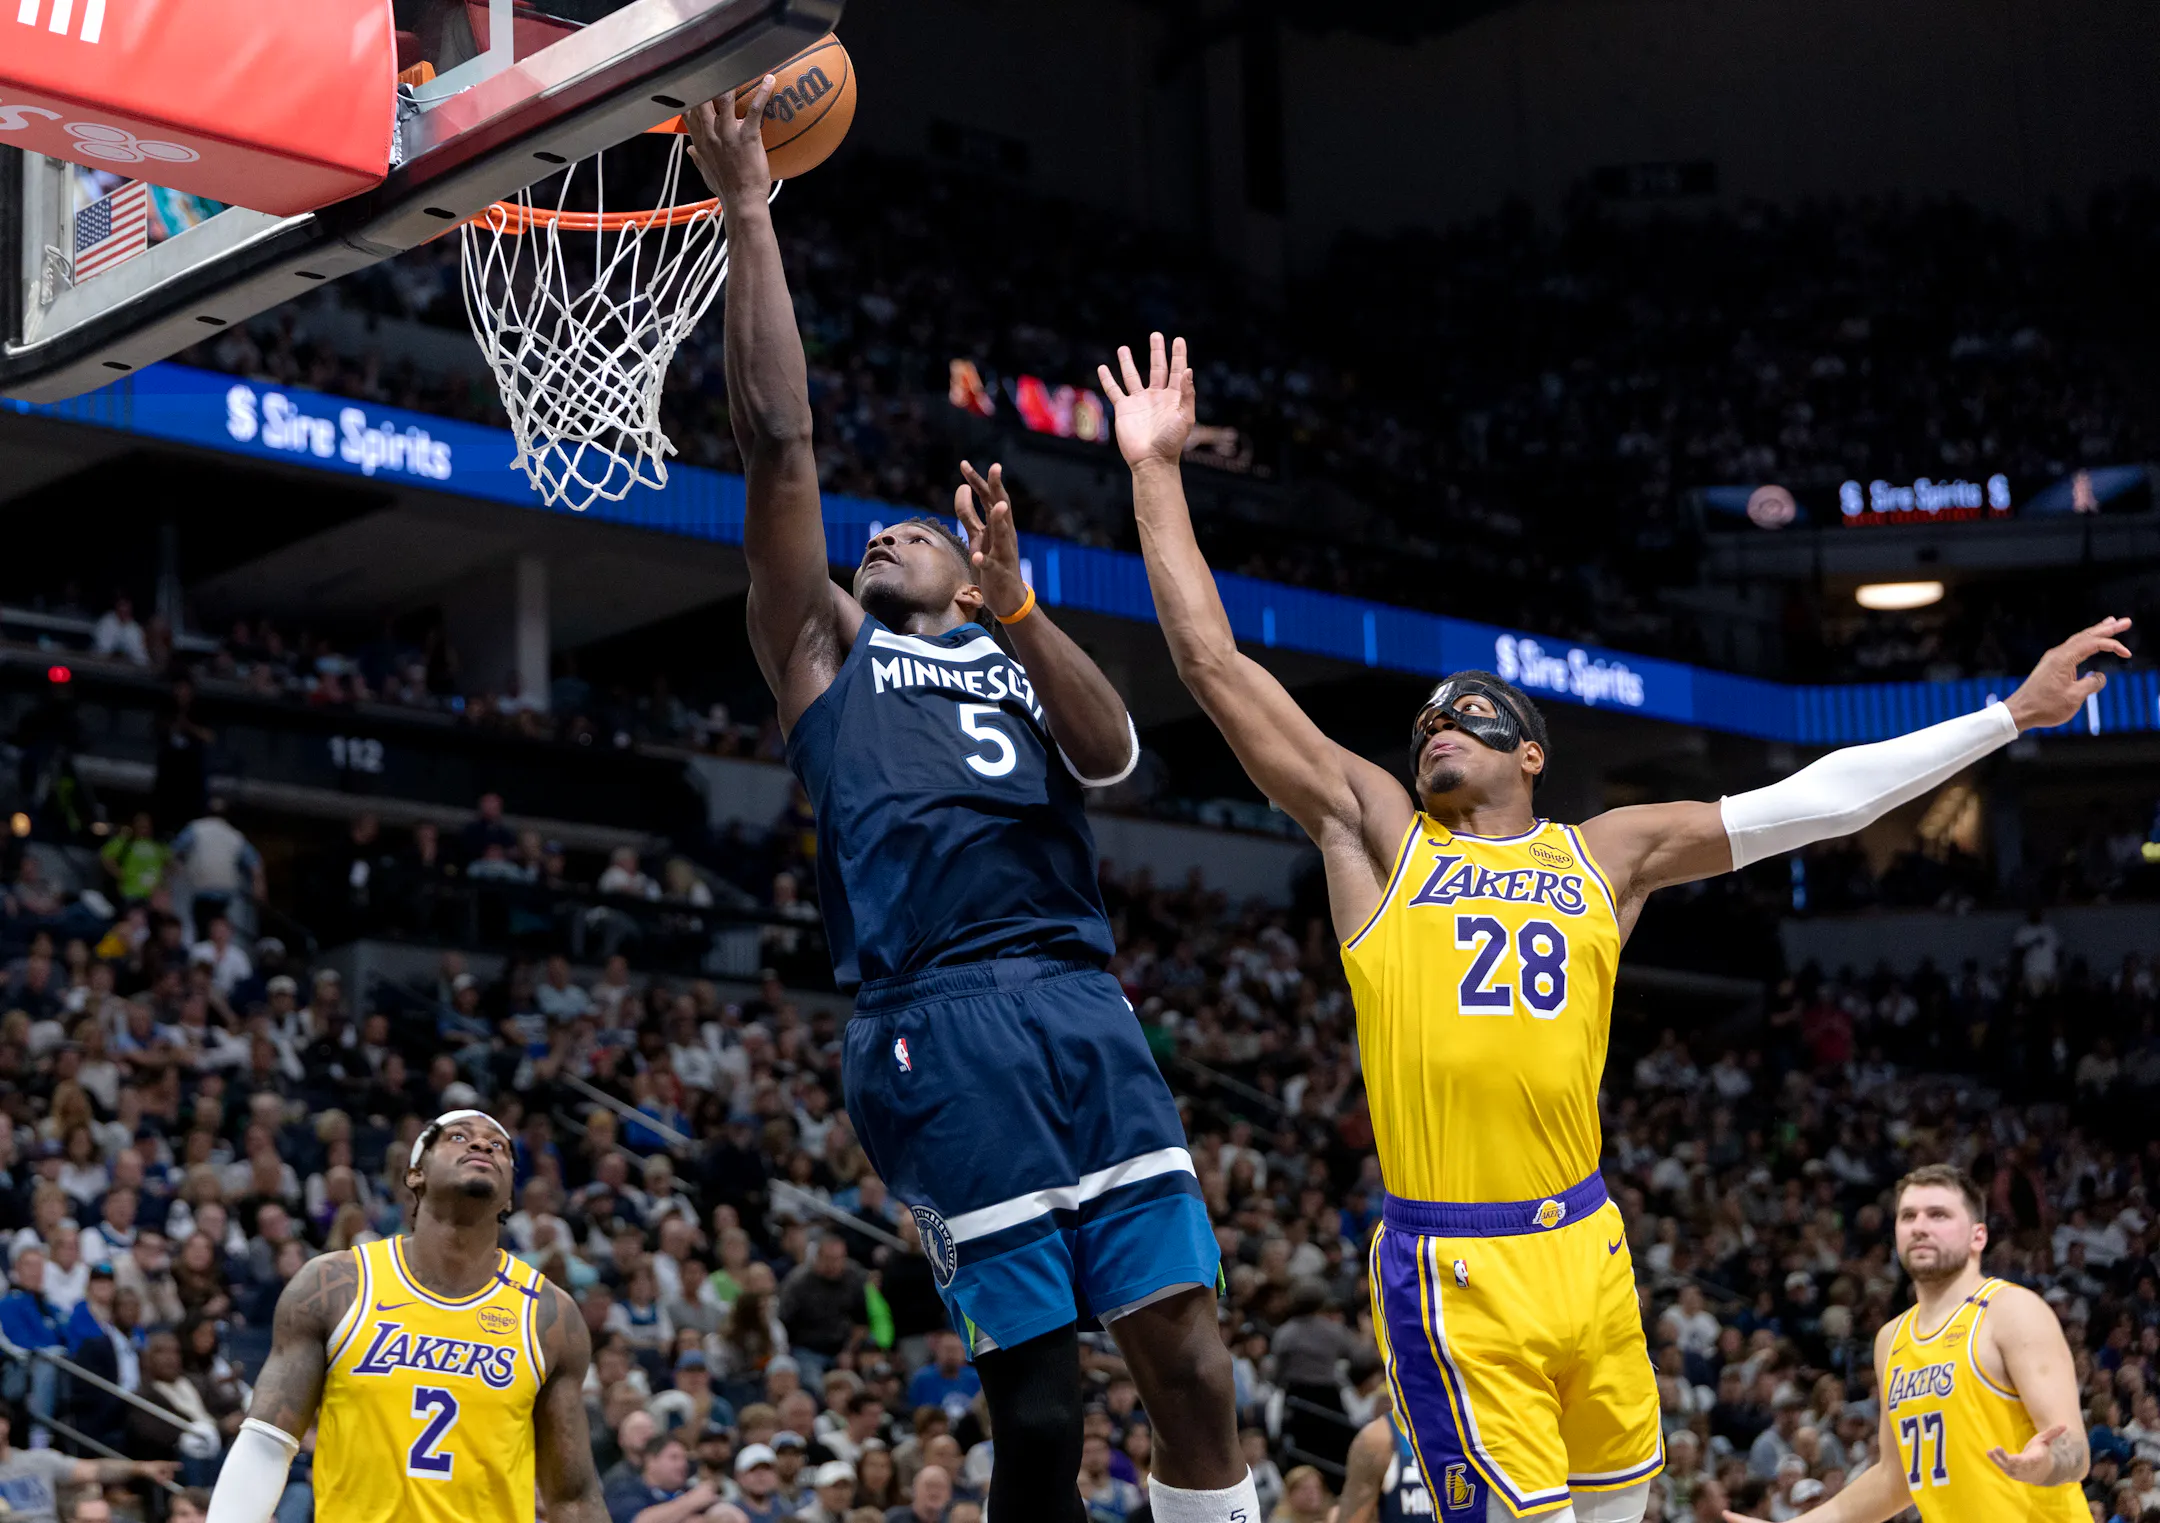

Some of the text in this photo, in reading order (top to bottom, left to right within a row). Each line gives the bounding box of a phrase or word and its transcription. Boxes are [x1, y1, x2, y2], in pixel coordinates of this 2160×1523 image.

[761, 66, 834, 128] Wils
[262, 391, 335, 458] Sire
[340, 407, 452, 480] Spirits
[1519, 638, 1570, 693] Sire
[1568, 648, 1644, 707] Spirits
[327, 736, 384, 773] 112
[957, 703, 1019, 779] 5
[1408, 854, 1589, 917] LAKERS
[1454, 914, 1569, 1020] 28
[916, 1209, 955, 1271] TIMBERWOLVES
[350, 1320, 518, 1390] LAKERS
[1888, 1361, 1956, 1413] LAKERS
[406, 1385, 460, 1481] 2
[1900, 1410, 1950, 1492] 77
